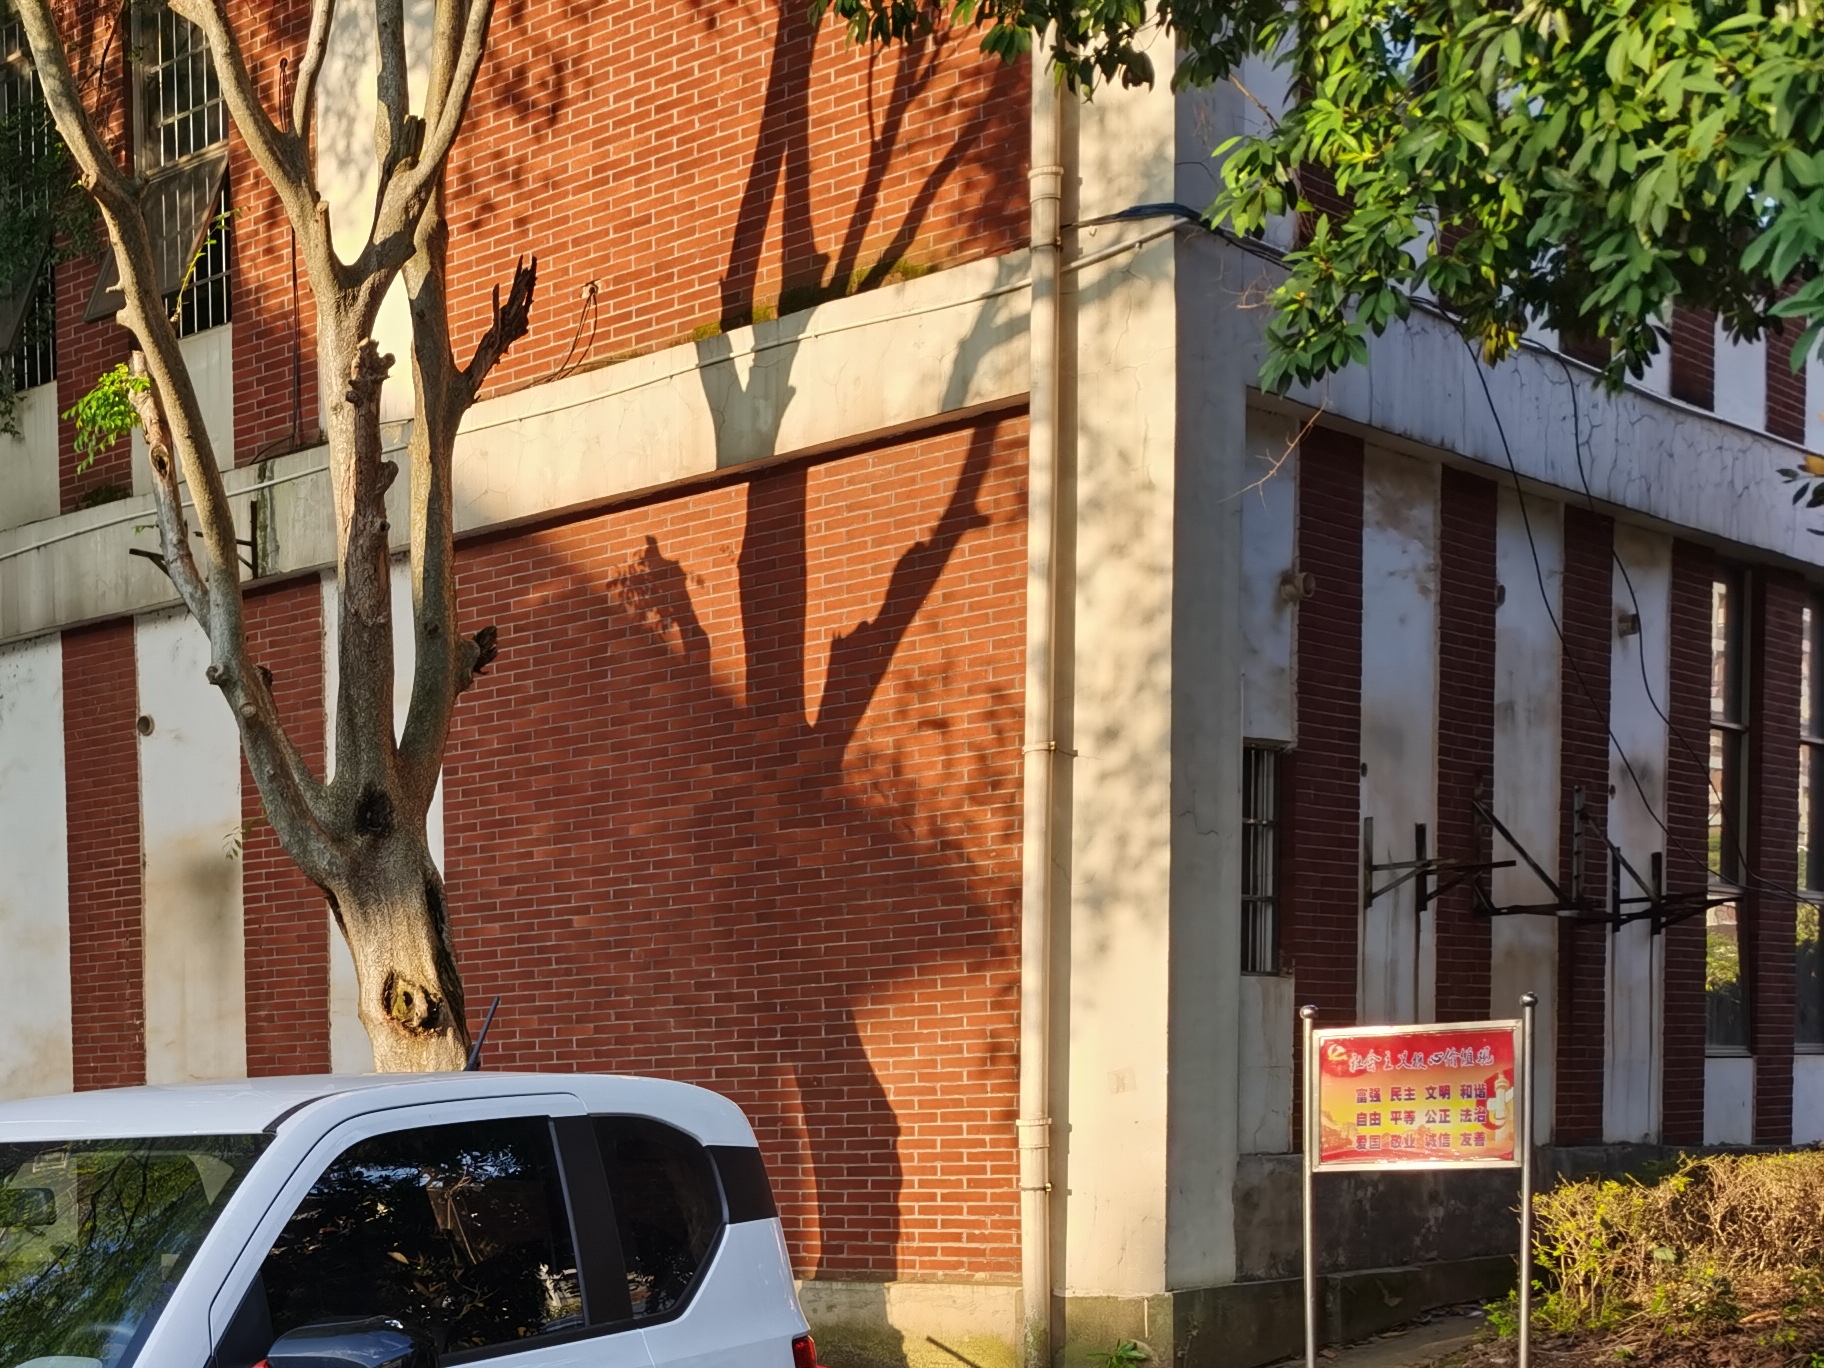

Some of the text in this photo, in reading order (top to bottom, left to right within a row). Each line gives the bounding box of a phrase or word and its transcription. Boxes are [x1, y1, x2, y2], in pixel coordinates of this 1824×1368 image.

[1349, 1045, 1495, 1073] 社会主义核心价值观
[1355, 1082, 1487, 1104] 富强 民主 文明 和谐
[1355, 1106, 1486, 1127] 自由 平等 公正 法治
[1355, 1130, 1486, 1151] 爱国 敬业 诚信 友善
